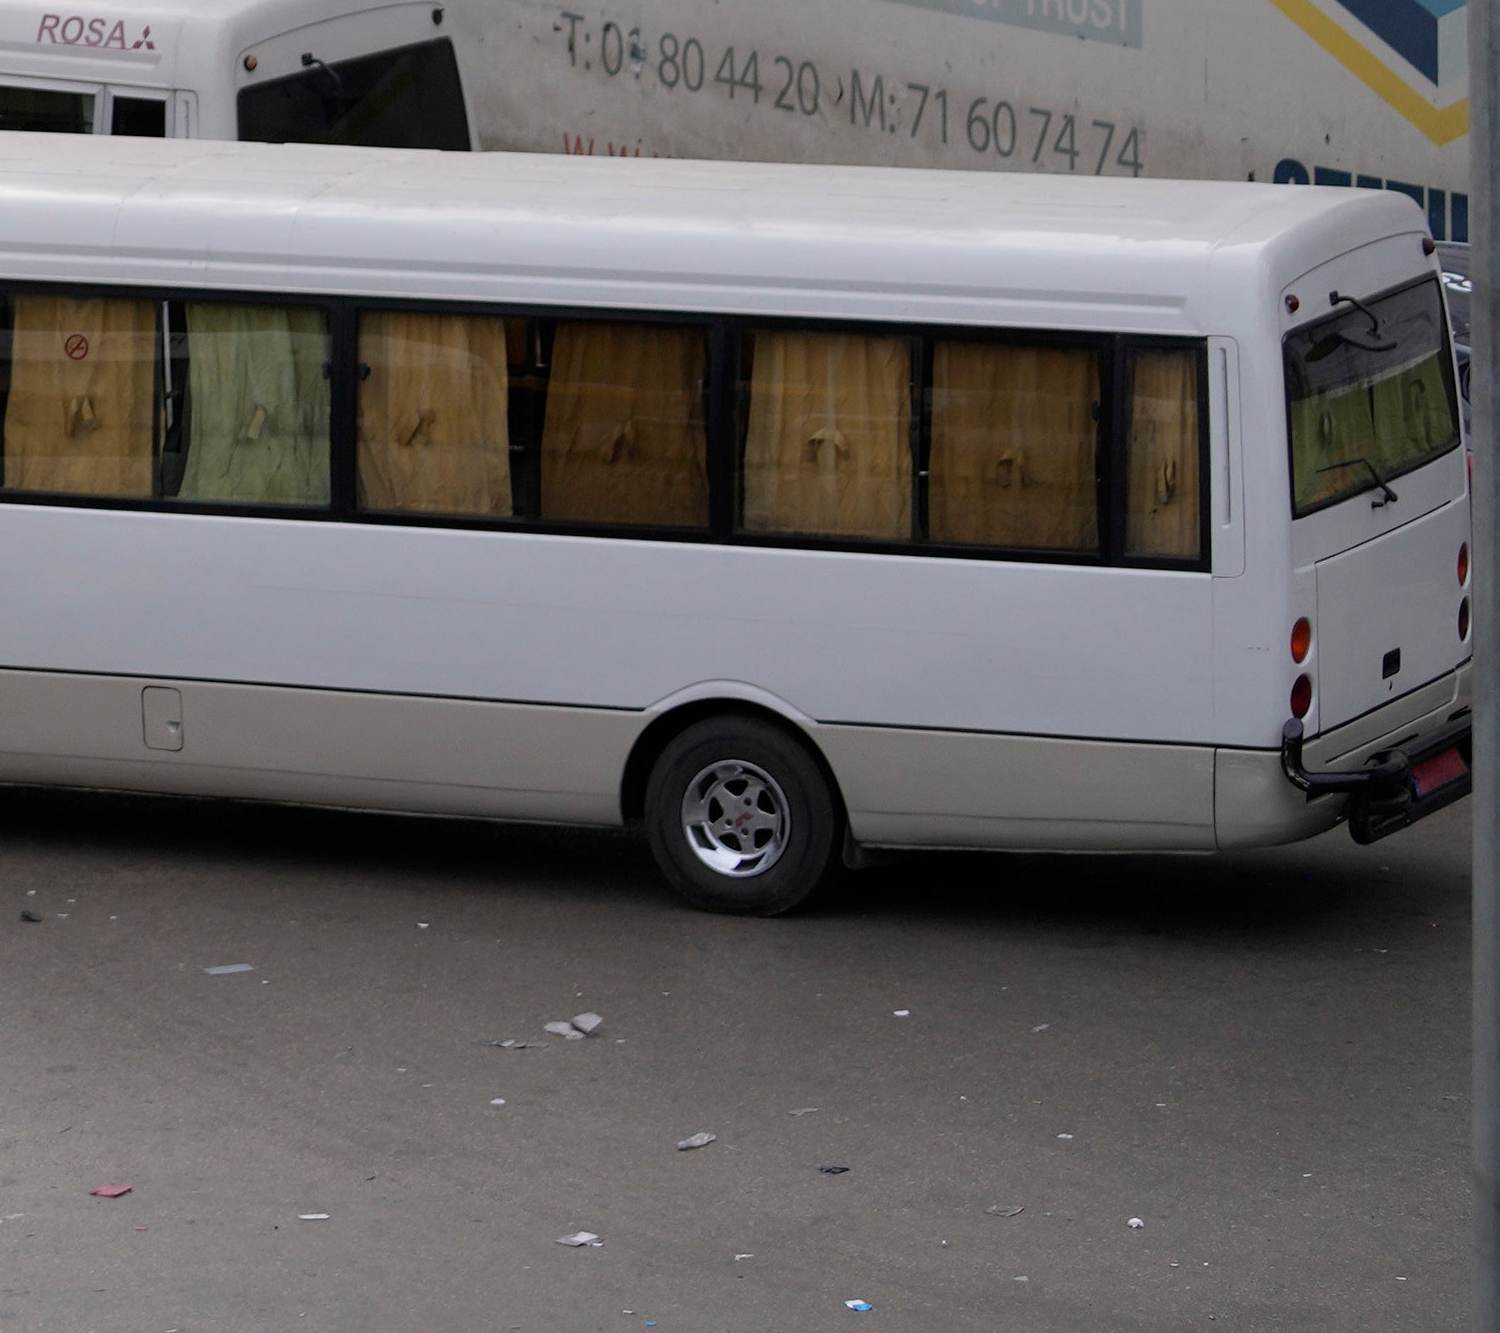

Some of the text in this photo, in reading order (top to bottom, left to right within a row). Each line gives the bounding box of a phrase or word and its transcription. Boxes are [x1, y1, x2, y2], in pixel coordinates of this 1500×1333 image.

[36, 13, 127, 50] ROSA
[657, 32, 705, 93] 80
[714, 46, 764, 104] 44
[774, 55, 821, 117] 20
[906, 82, 950, 145] 71
[967, 96, 1017, 159] 60
[1028, 106, 1081, 172] 74
[1090, 119, 1145, 179] 74
